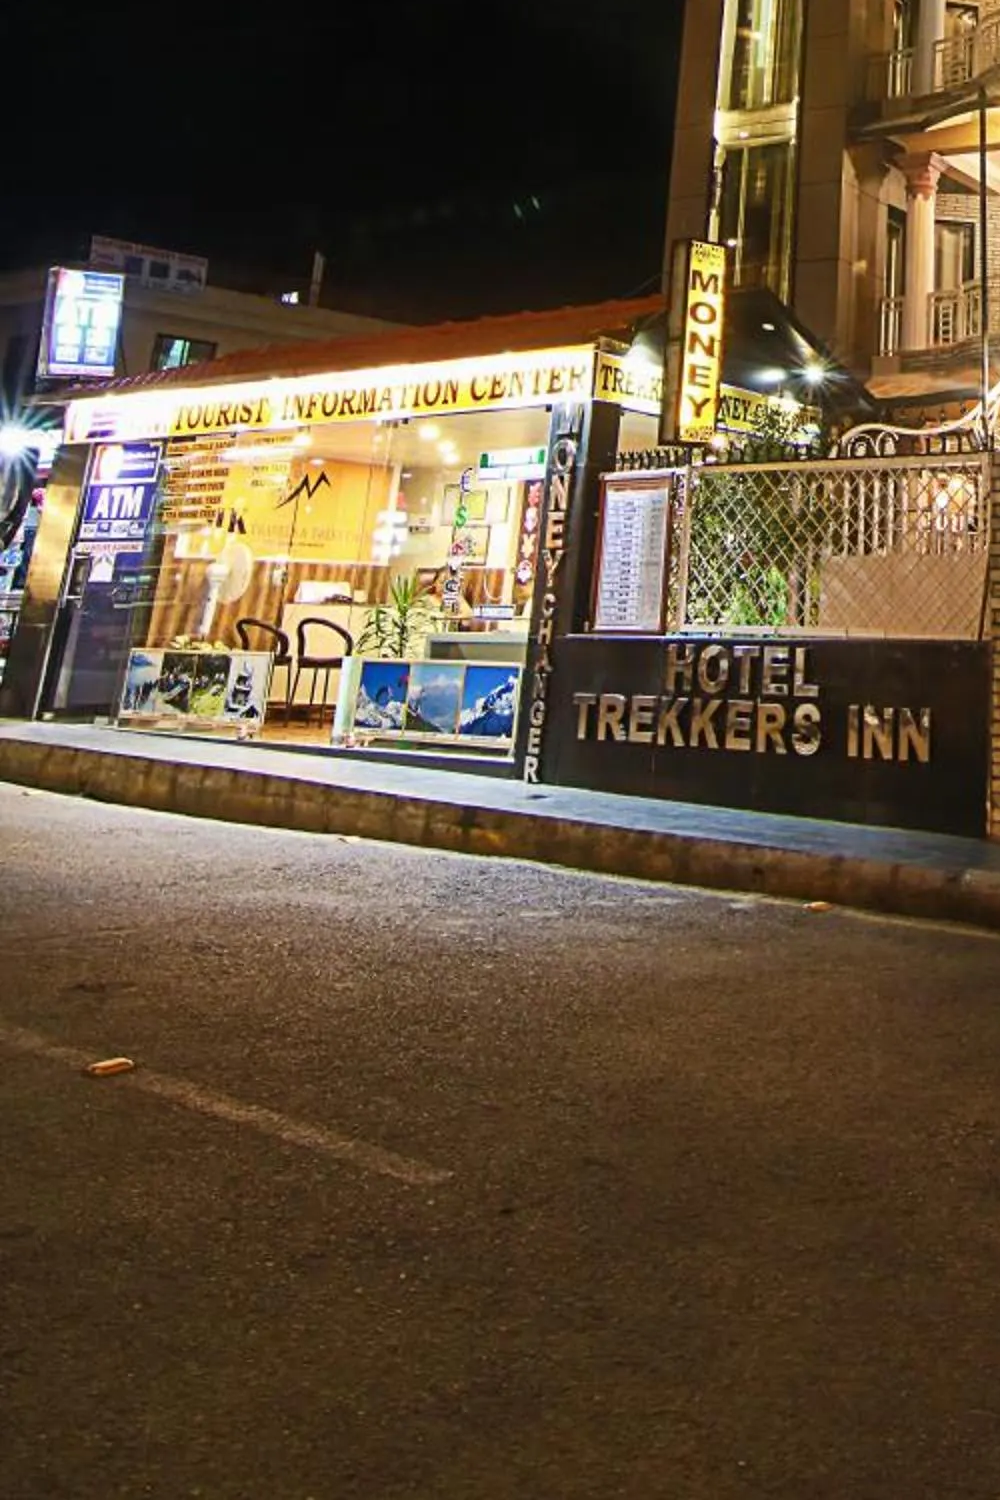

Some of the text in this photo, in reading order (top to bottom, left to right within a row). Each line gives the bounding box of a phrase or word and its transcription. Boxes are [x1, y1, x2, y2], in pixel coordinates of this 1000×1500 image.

[687, 269, 720, 419] MONEY
[174, 365, 587, 431] TOURIST INFORMATION CENTER
[91, 485, 145, 519] ATM
[523, 402, 585, 784] MONEY CHANGER
[666, 643, 820, 697] HOTEL
[572, 692, 931, 763] TREKKERS INN
